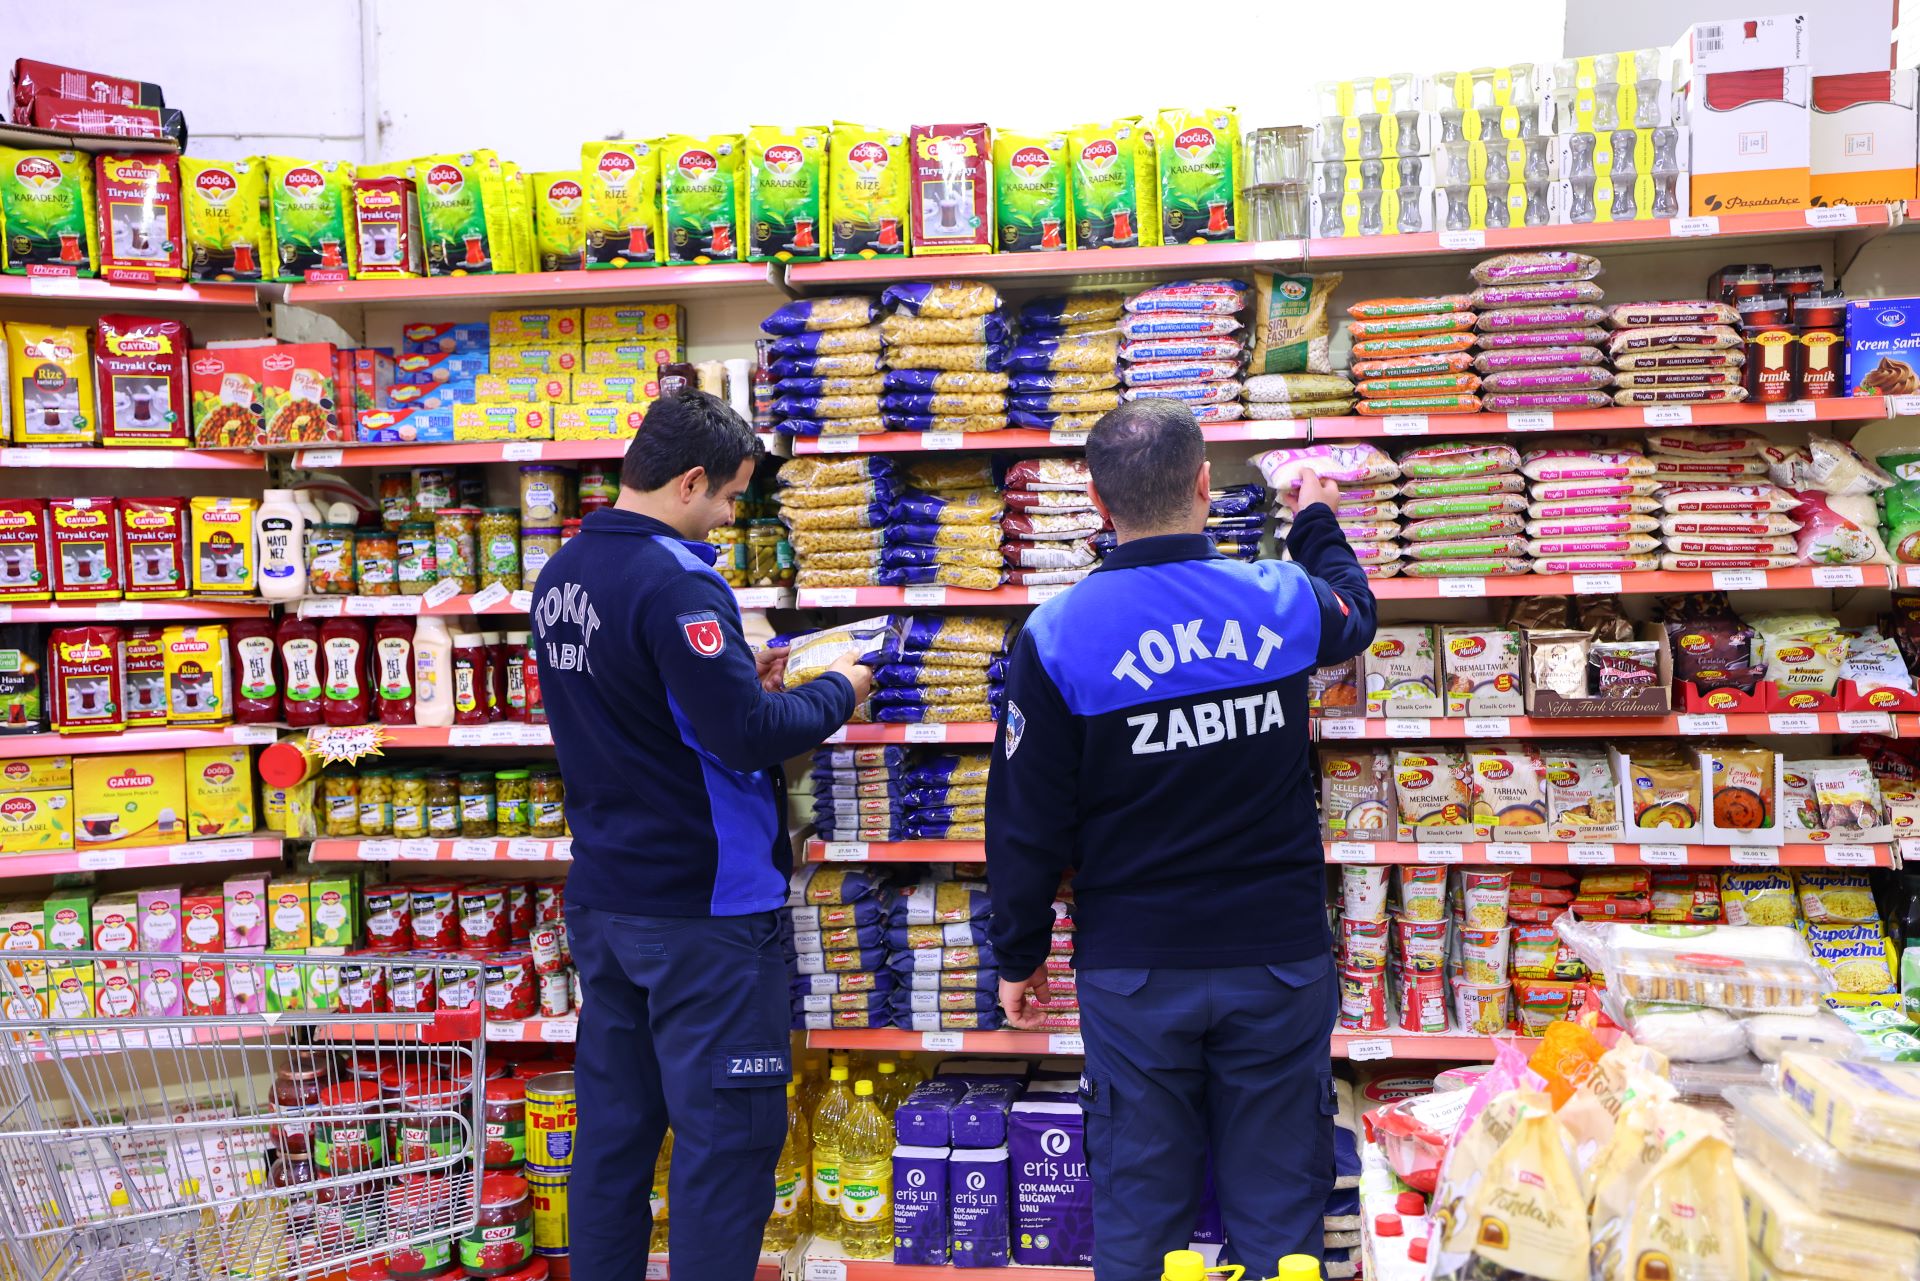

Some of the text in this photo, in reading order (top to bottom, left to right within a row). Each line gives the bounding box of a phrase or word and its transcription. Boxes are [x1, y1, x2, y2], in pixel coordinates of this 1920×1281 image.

[1180, 133, 1209, 144] DOĞUŞ
[1086, 143, 1112, 156] DOĞUŞ
[602, 159, 629, 168] DOĞUŞ
[684, 156, 712, 166] DOĞUŞ
[1016, 154, 1045, 163] DOĞUŞ
[1170, 162, 1220, 175] KARADENİZ
[200, 175, 230, 186] DOĞUŞ
[430, 172, 457, 182] DOĞUŞ
[675, 184, 722, 194] KARADENİZ
[759, 179, 807, 189] KARADENİZ
[856, 180, 880, 190] RİZE
[552, 187, 578, 196] DOĞUŞ
[605, 190, 628, 199] RİZE
[205, 208, 230, 217] RİZE
[556, 216, 577, 225] RİZE
[1630, 316, 1647, 324] Yayla
[1883, 314, 1900, 322] Kent
[1268, 319, 1288, 332] SIRA
[1267, 325, 1304, 342] FASULYE
[1856, 337, 1920, 350] Krem Şant
[110, 360, 172, 372] Tiryaki Çayı
[38, 368, 62, 379] Rize
[1760, 372, 1790, 383] irmik
[1804, 372, 1834, 383] irmik
[56, 532, 109, 540] Tiryaki Çayı
[126, 532, 176, 540] Tiryaki Çayı
[212, 534, 230, 544] Rize
[267, 536, 286, 547] MAYO
[270, 549, 284, 559] NEZ
[1372, 643, 1392, 652] Bizim
[1452, 640, 1473, 650] Bizim
[1112, 619, 1283, 691] TOKAT
[250, 658, 264, 668] KET
[294, 660, 308, 670] KET
[334, 659, 348, 669] KET
[387, 659, 401, 670] KET
[1390, 664, 1411, 672] YAYLA
[1454, 663, 1508, 672] KREMALI TAVUK
[61, 665, 112, 674] Tiryaki Çayı
[182, 664, 200, 674] Rize
[252, 668, 265, 678] CAP
[336, 669, 349, 679] CAP
[388, 669, 401, 679] CAP
[296, 670, 309, 679] CAP
[1788, 674, 1824, 683] PUDİNG
[2, 676, 24, 684] Hasat
[1709, 695, 1730, 706] Bizim
[1790, 696, 1810, 706] Bizim
[1498, 702, 1516, 710] Çorba
[1541, 700, 1659, 716] Nefis Türk Kahvesi
[1127, 690, 1285, 755] ZABITA
[208, 766, 230, 775] DOĞUŞ
[1479, 762, 1500, 773] Bizim
[1888, 762, 1913, 774] Maya
[110, 776, 152, 788] ÇAYKUR
[1399, 772, 1420, 783] Bizim
[220, 786, 240, 794] LABEL
[1333, 784, 1378, 794] KELLE PAÇA
[1493, 788, 1528, 796] TARHANA
[1410, 794, 1449, 803] MERCİMEK
[5, 802, 31, 811] DOĞUŞ
[22, 824, 48, 832] LABEL
[732, 1058, 784, 1073] ZABITA
[333, 1129, 363, 1139] eser
[1024, 1157, 1088, 1179] eriş un
[844, 1188, 879, 1198] Anadolu
[1019, 1183, 1075, 1195] ÇOK AMAÇLI
[896, 1188, 937, 1203] eriş un
[955, 1192, 997, 1206] eriş un
[1020, 1192, 1056, 1203] BUĞDAY
[894, 1208, 917, 1217] BUĞDAY
[907, 1204, 928, 1212] AMAÇLI
[954, 1207, 989, 1216] ÇOK AMAÇLI
[1020, 1204, 1039, 1213] UNU
[954, 1212, 977, 1221] BUĞDAY
[484, 1227, 513, 1239] eser
